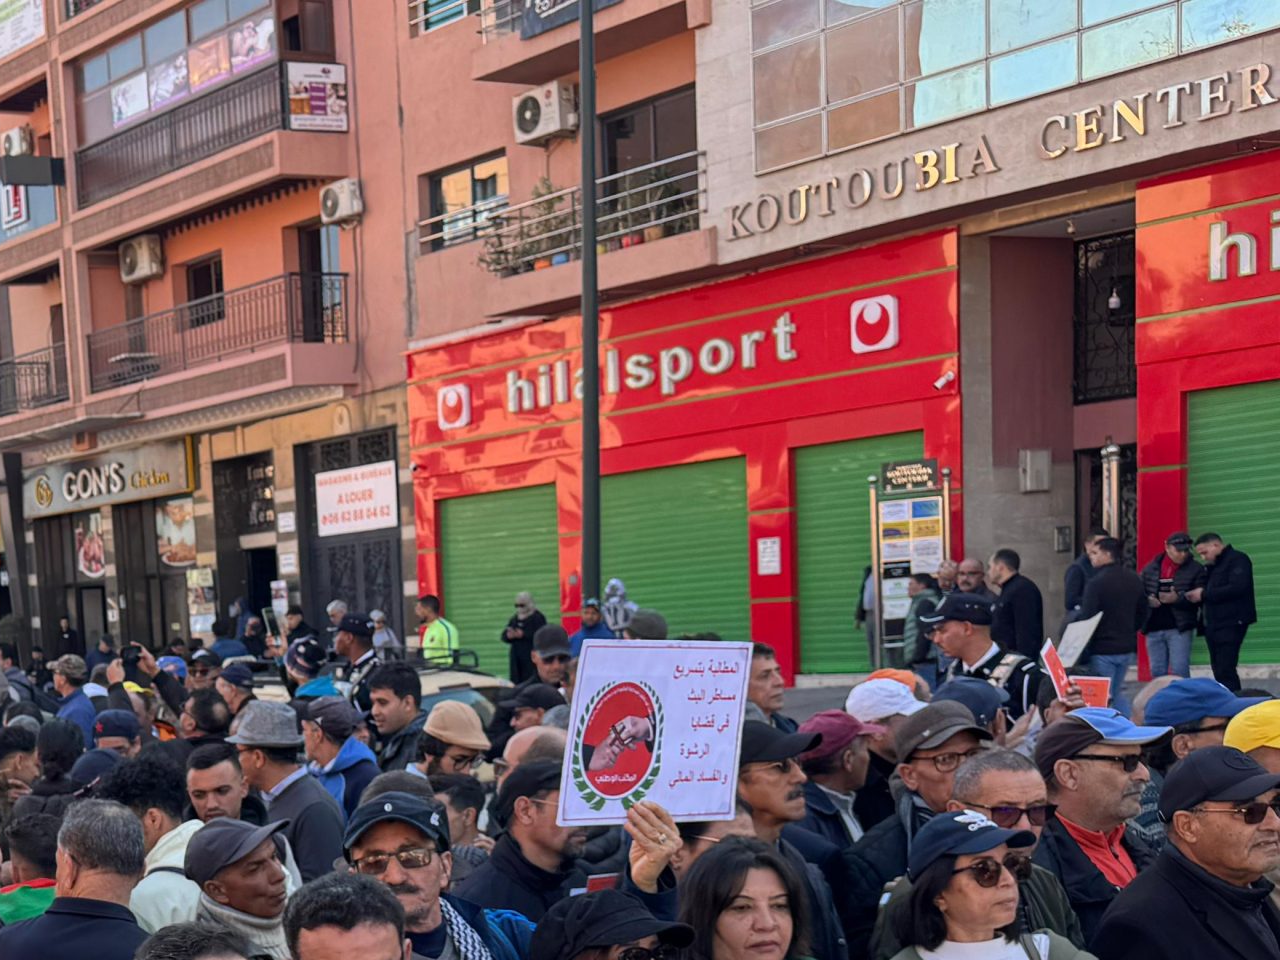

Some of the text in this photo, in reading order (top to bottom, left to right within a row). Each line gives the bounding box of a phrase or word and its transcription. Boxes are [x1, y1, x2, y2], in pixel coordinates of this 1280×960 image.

[725, 62, 1280, 242] KOUTOUBIA CENTER
[62, 462, 124, 501] GON'S
[345, 488, 374, 504] LOUER
[673, 661, 705, 680] بتسريع
[680, 743, 710, 759] الرشوة
